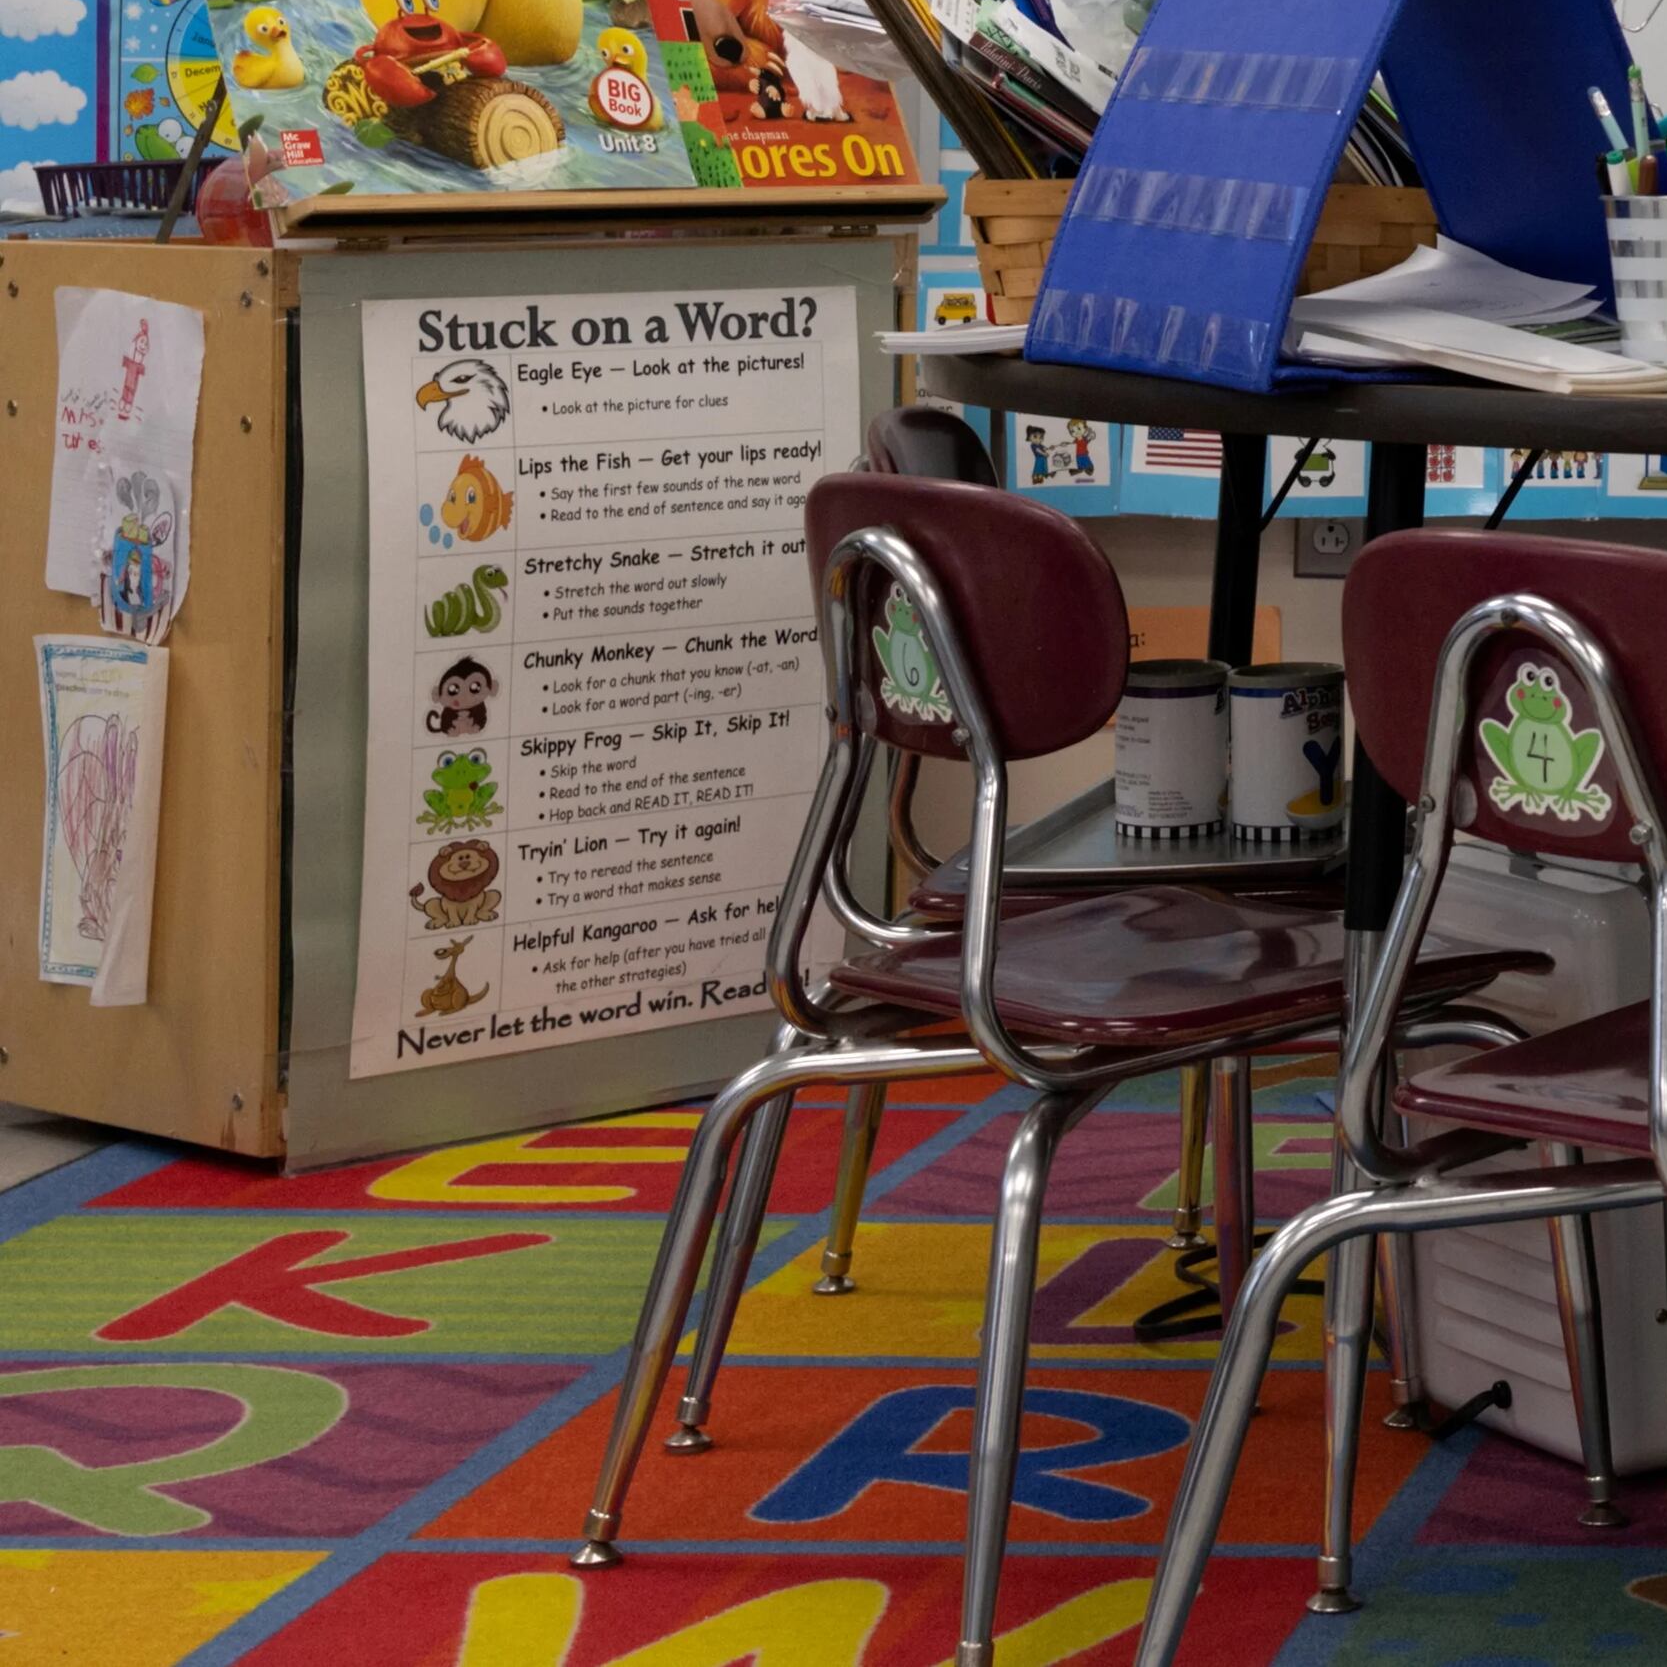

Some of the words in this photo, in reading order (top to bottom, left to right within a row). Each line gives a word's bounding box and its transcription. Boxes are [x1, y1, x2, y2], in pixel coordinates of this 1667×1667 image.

[608, 80, 641, 102] BIG
[609, 100, 642, 117] Book
[601, 135, 640, 152] Unit
[642, 135, 656, 152] 8
[418, 306, 558, 352] Stuck
[572, 316, 631, 346] on
[645, 318, 668, 344] a
[675, 298, 816, 341] Word?
[902, 642, 919, 686] 6
[1525, 731, 1554, 783] 4
[397, 1026, 484, 1058] Never
[491, 1015, 524, 1038] let
[530, 1008, 572, 1032] the
[579, 995, 642, 1023] word
[648, 990, 693, 1016] win.
[701, 978, 766, 1009] Read
